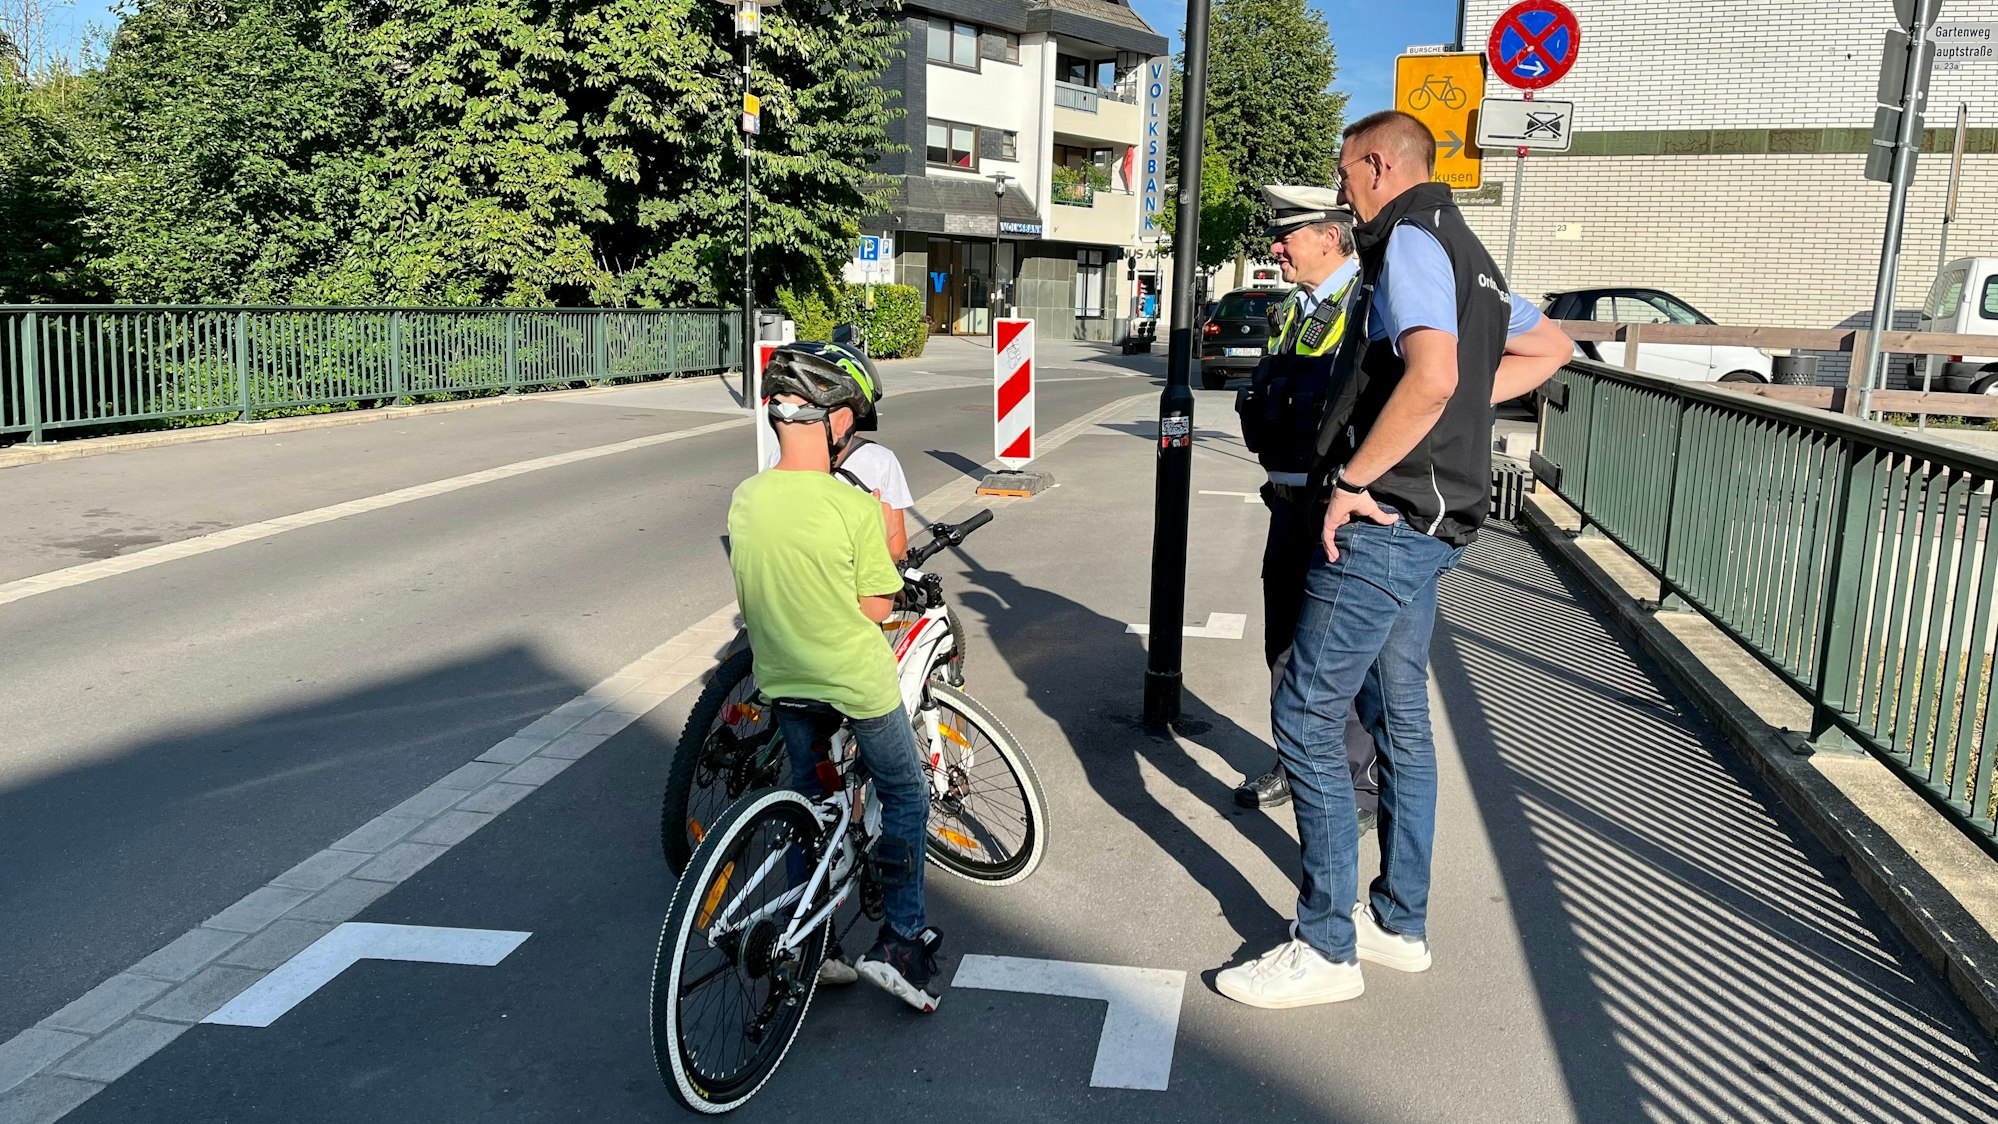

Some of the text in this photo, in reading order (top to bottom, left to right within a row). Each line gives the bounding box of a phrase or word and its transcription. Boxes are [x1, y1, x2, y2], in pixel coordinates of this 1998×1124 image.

[1935, 26, 1991, 40] Gartenweg
[1934, 45, 1993, 60] auptstraße
[1944, 62, 1959, 70] 23a
[1144, 63, 1164, 231] VOLKSBANK
[1433, 171, 1473, 183] kusen
[1557, 224, 1567, 232] 23
